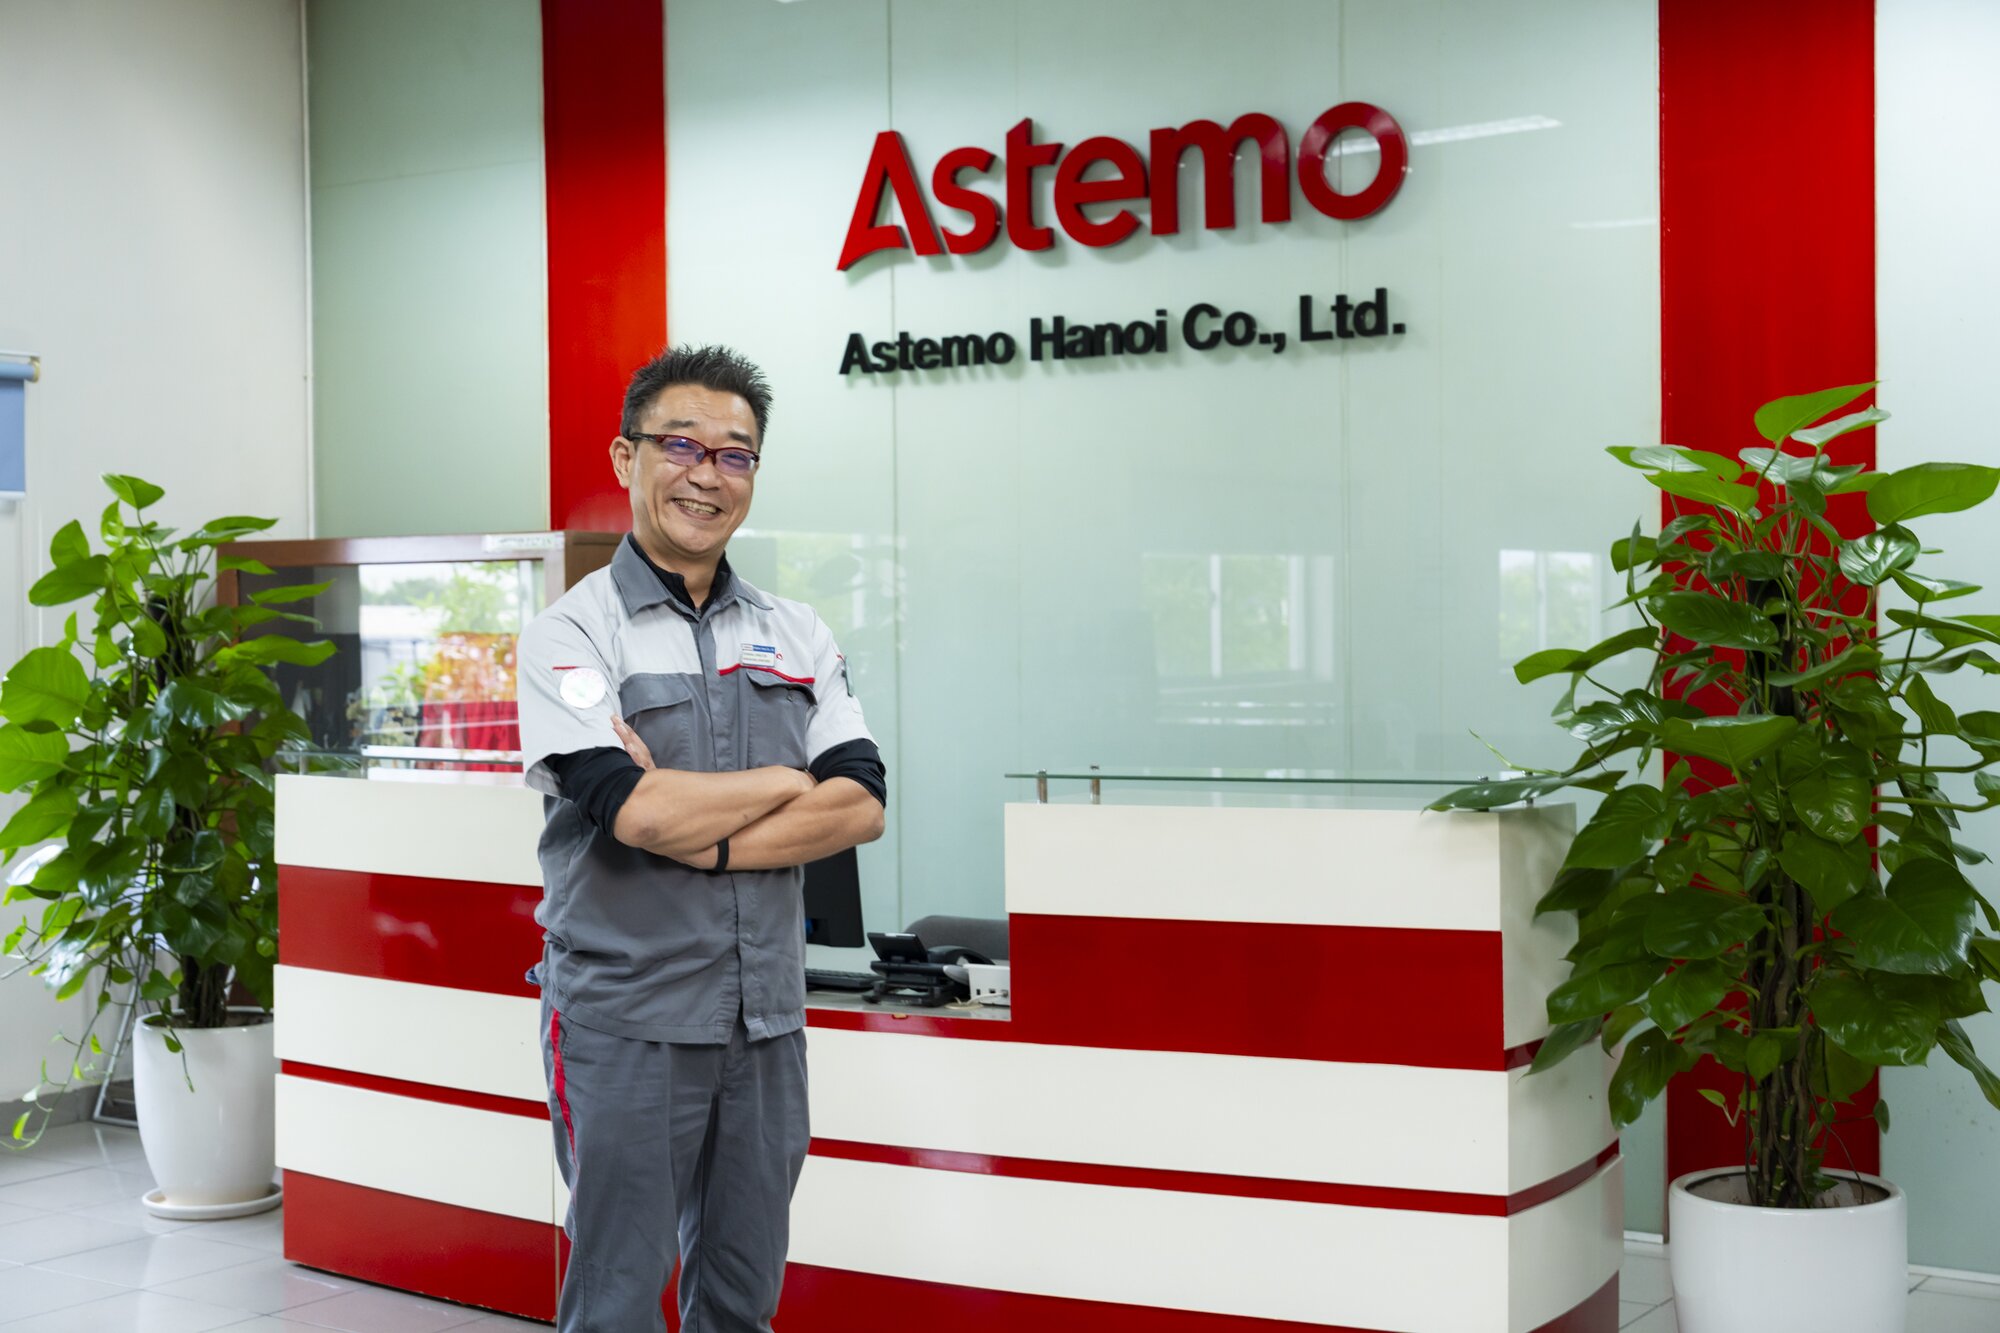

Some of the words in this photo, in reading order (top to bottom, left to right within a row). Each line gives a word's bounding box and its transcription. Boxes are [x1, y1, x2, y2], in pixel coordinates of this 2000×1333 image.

[836, 102, 1408, 271] Astemo
[839, 331, 1016, 375] Astemo
[1030, 309, 1168, 361] Hanoi
[1182, 303, 1286, 354] Co.,
[1299, 287, 1406, 342] Ltd.
